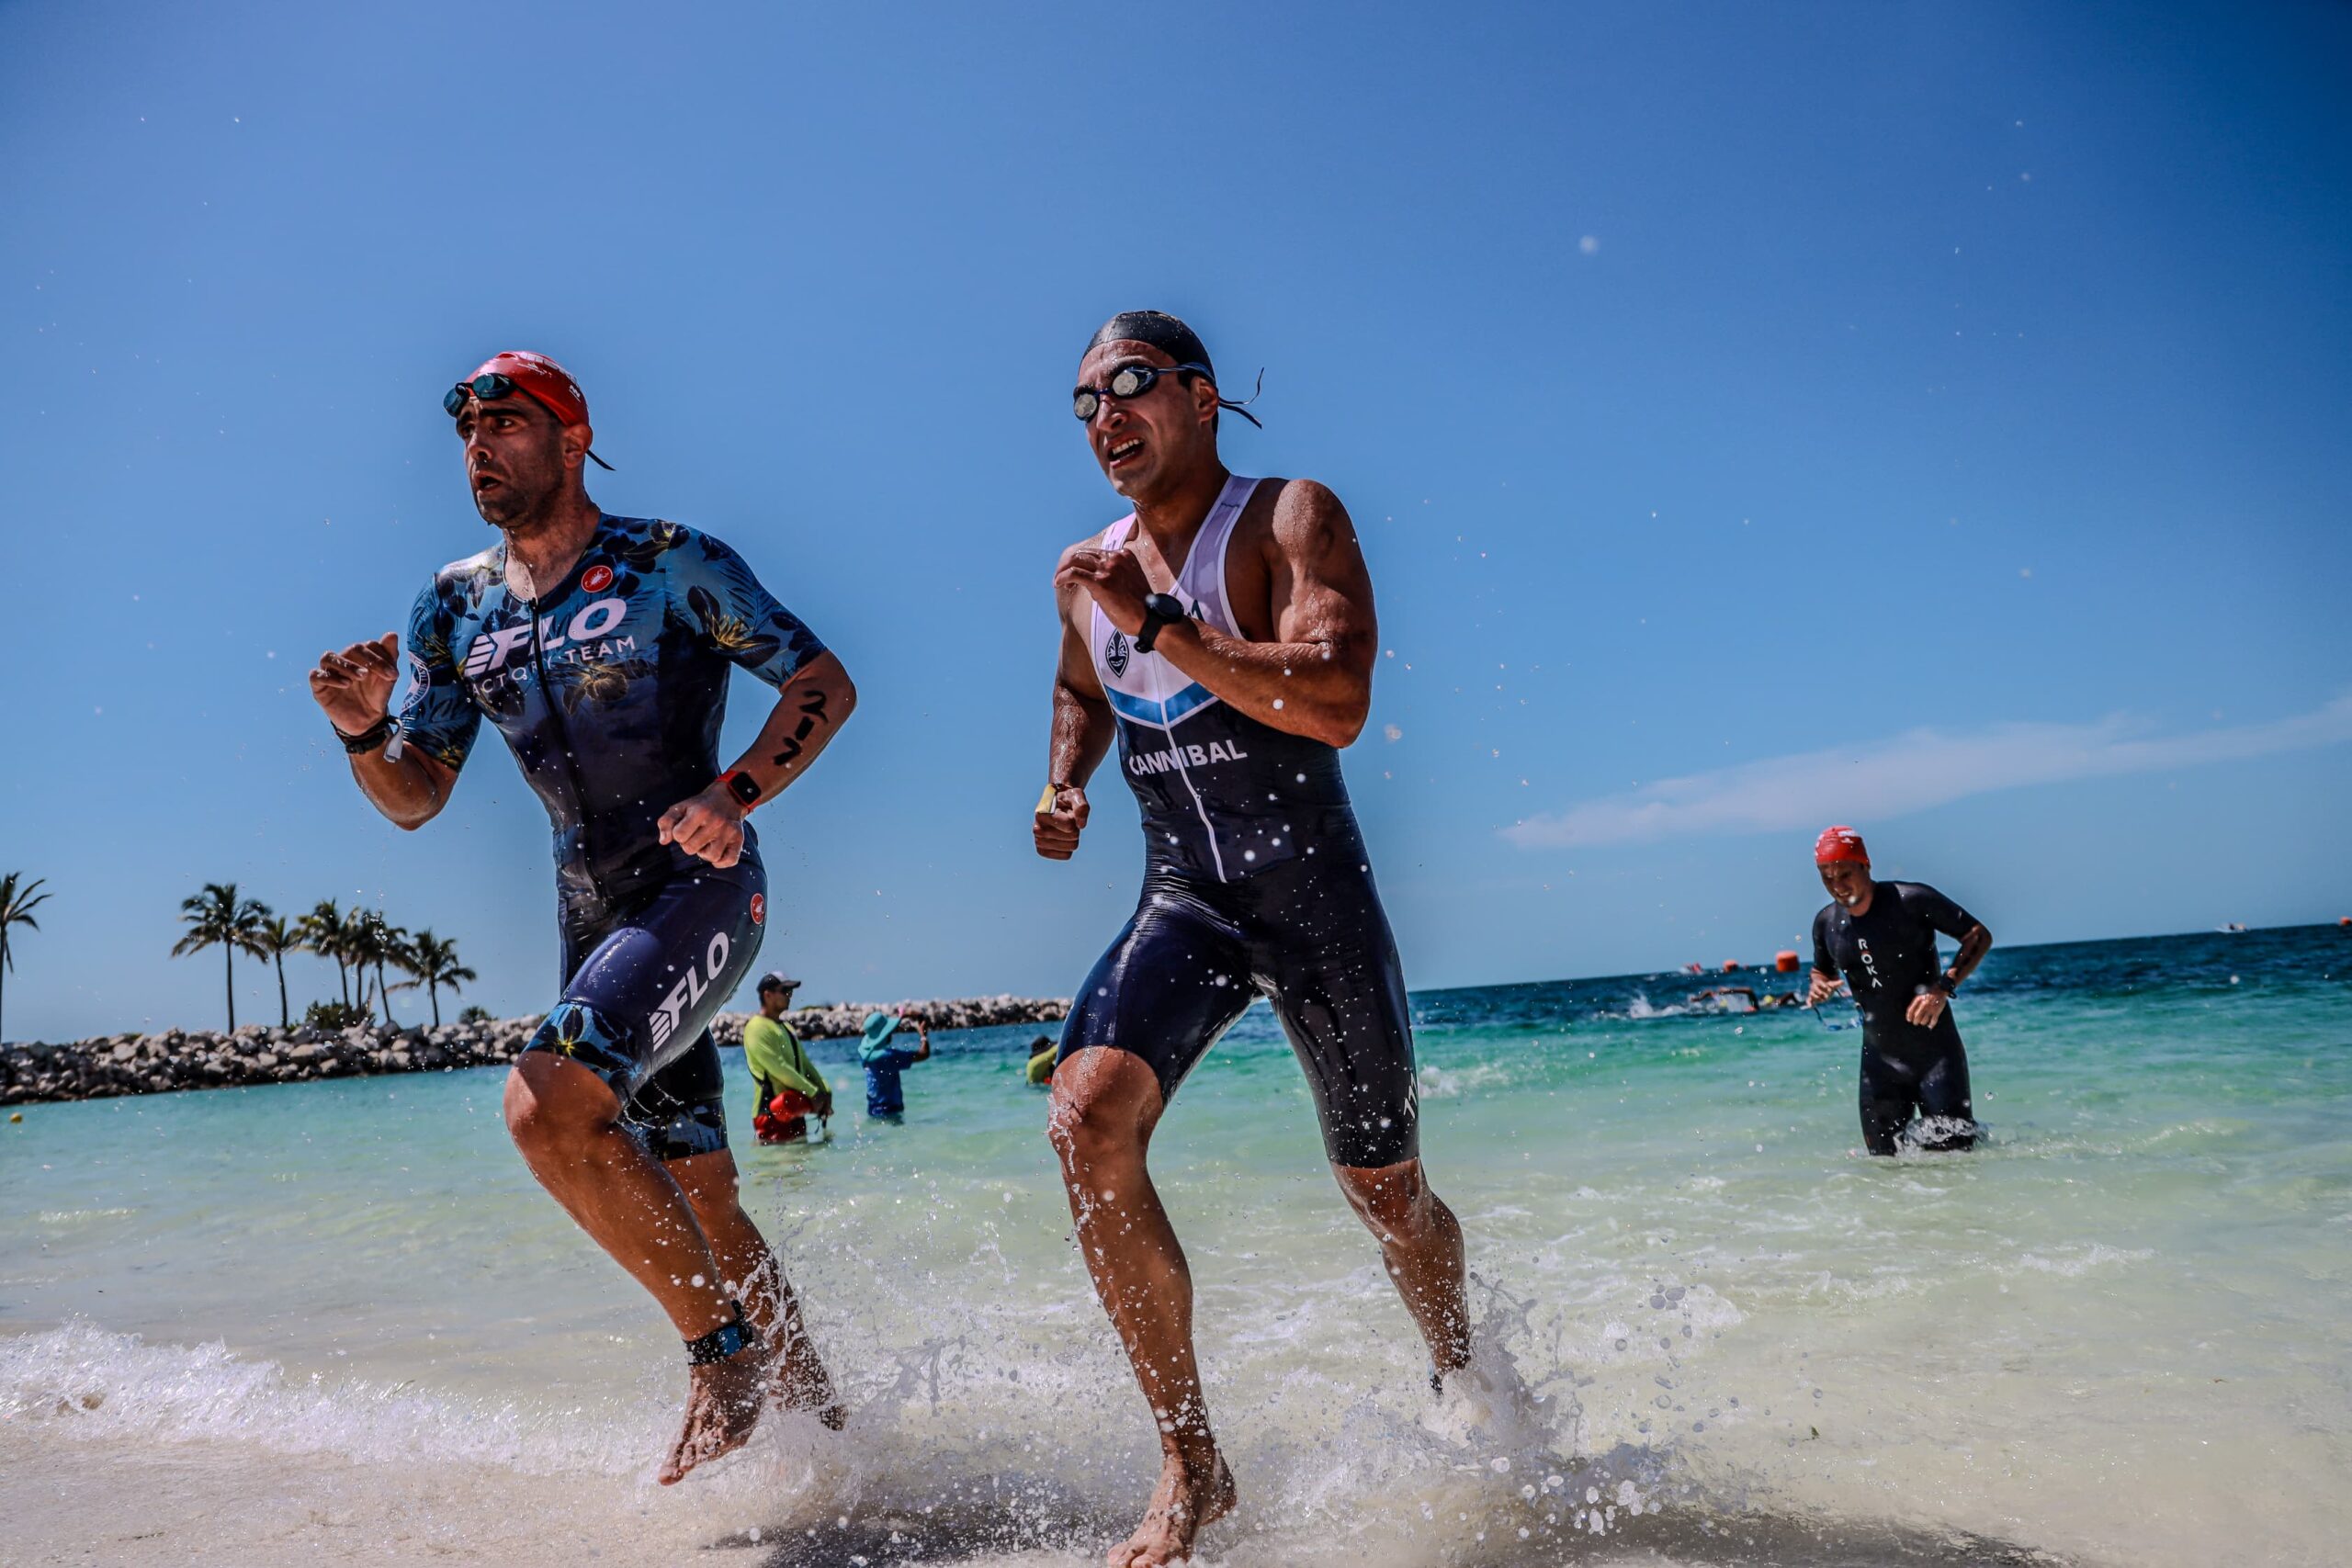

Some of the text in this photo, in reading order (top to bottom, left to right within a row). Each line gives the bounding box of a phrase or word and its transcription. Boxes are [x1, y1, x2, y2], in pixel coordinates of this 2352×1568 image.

[472, 636, 636, 695] ACTORY TEAM
[483, 598, 628, 675] FLO
[1128, 739, 1248, 775] CANNIBAL
[656, 931, 729, 1032] FLO
[1858, 938, 1883, 988] ROKA
